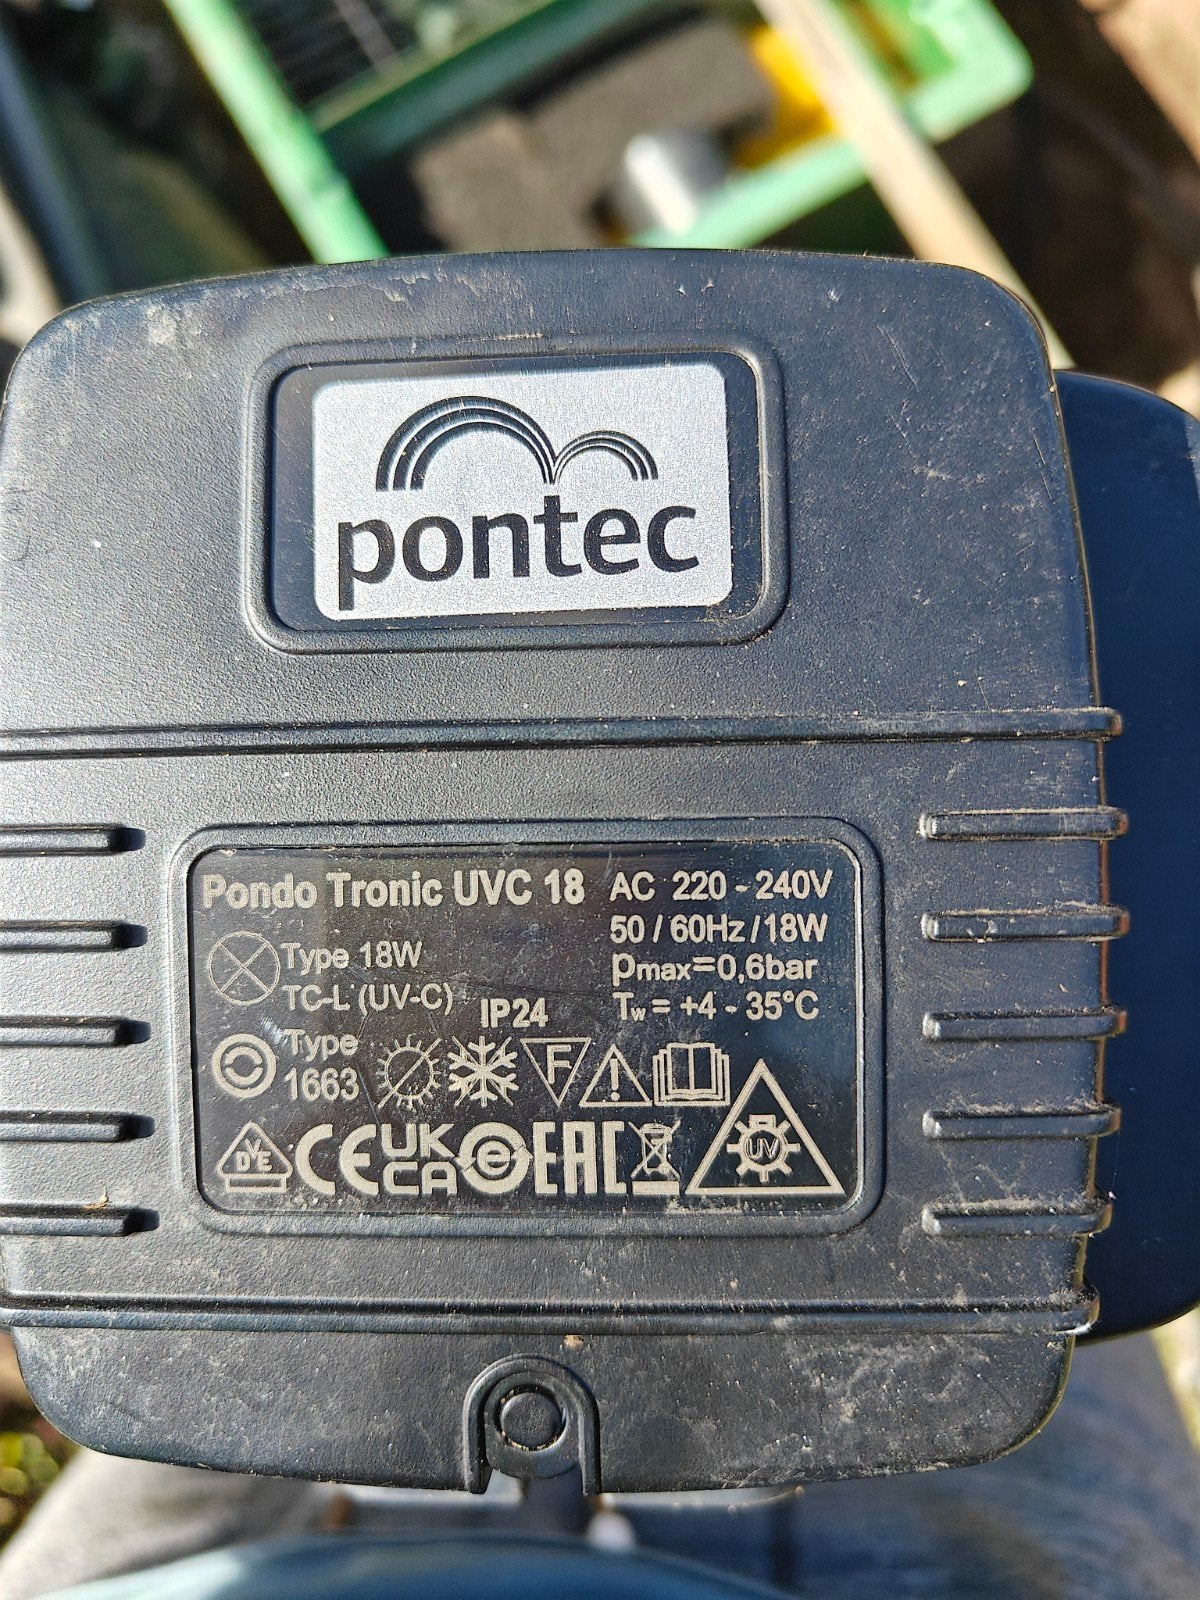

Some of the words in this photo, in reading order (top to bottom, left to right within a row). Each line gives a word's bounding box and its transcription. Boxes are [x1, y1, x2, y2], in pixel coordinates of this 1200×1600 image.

[338, 495, 700, 611] pontec
[203, 873, 318, 909] Pondo
[326, 870, 443, 907] Tronic
[453, 868, 533, 906] UVC
[544, 867, 585, 904] 18
[609, 870, 656, 901] AC
[672, 870, 727, 901] 220
[755, 869, 833, 900] 240V
[610, 914, 645, 944] 50
[281, 942, 350, 976] Type
[360, 940, 423, 969] 18W
[284, 984, 350, 1010] TC-L
[358, 982, 453, 1015] (UV-C)
[480, 998, 549, 1029] IP24
[746, 989, 819, 1021] 35°C
[284, 1028, 358, 1062] Type
[284, 1067, 359, 1101] 1663
[532, 1120, 627, 1195] EAC
